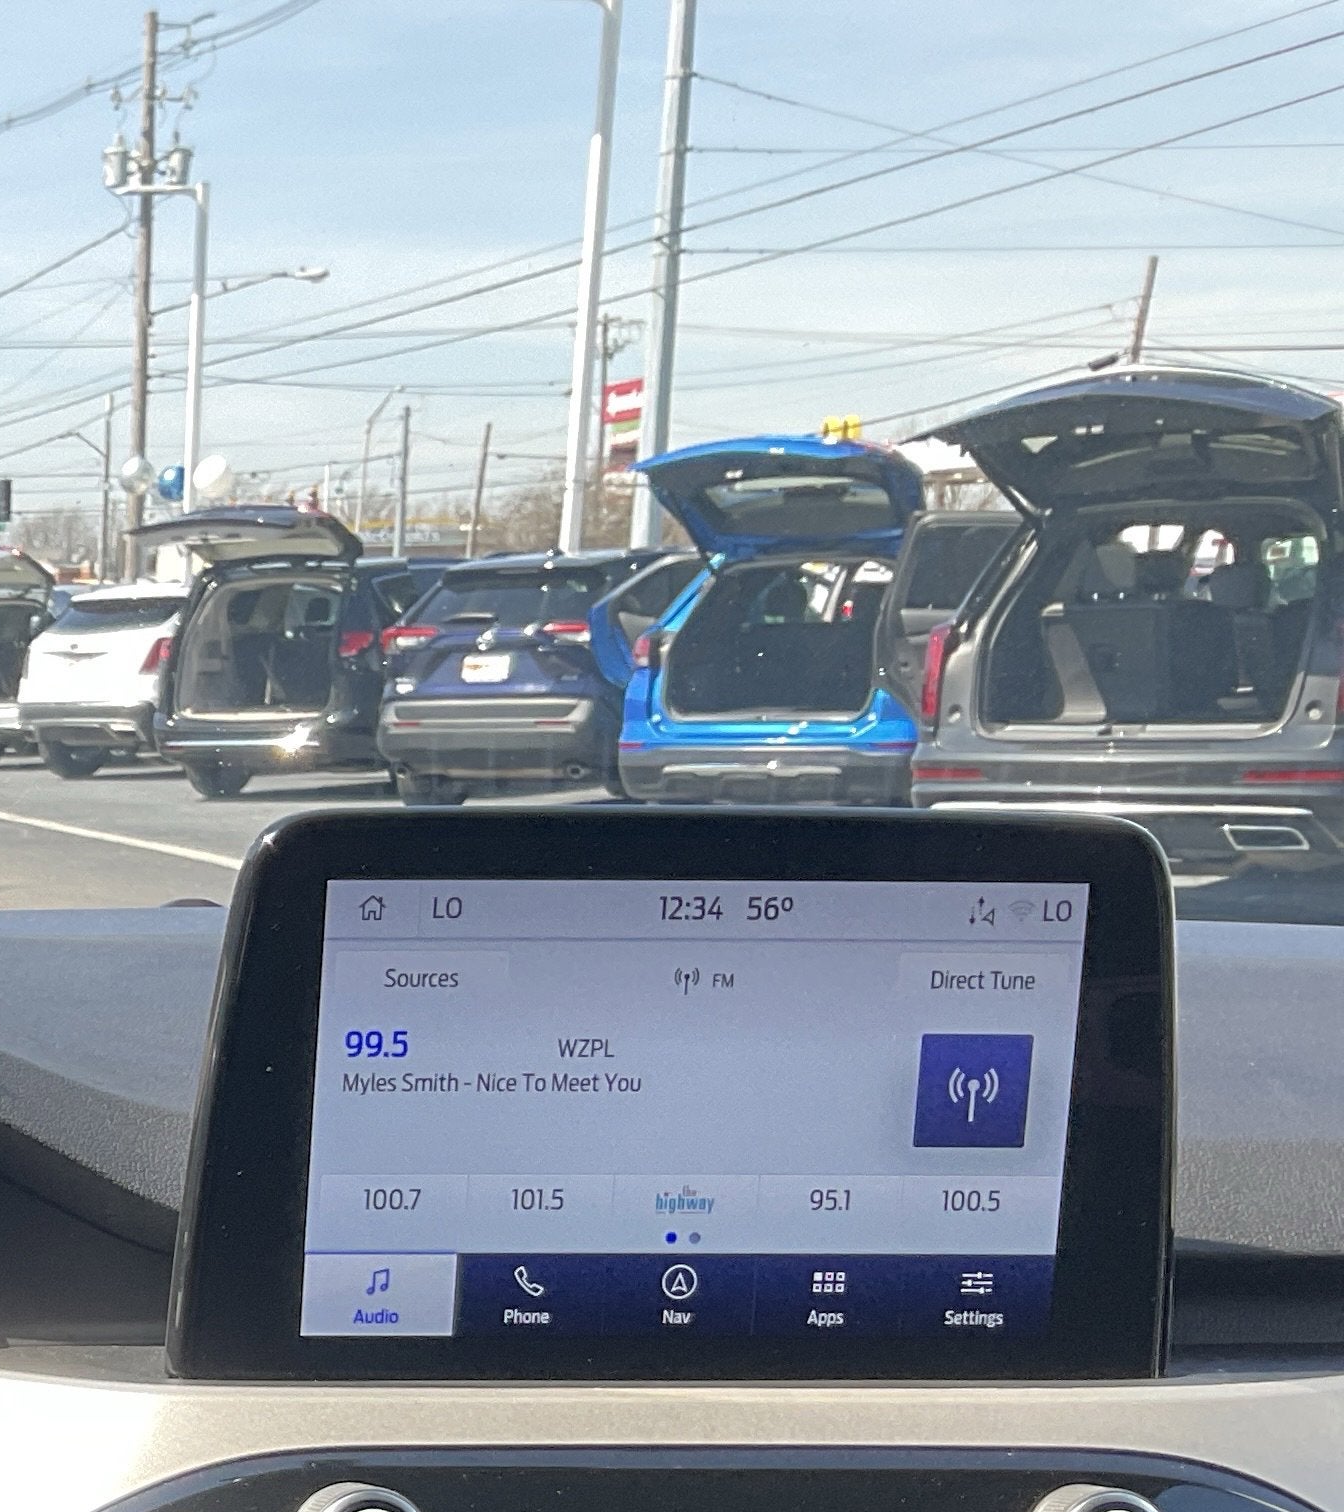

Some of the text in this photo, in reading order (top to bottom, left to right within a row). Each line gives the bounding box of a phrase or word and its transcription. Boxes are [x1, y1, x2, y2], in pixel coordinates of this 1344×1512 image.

[433, 896, 462, 919] LO
[660, 896, 724, 921] 12:34
[1043, 901, 1072, 922] LO
[384, 968, 459, 988] Sources
[713, 973, 734, 988] FM
[931, 971, 1036, 990] Direct Tune
[345, 1030, 409, 1058] 99.5
[558, 1038, 615, 1058] WZPL
[342, 1073, 396, 1096] Myles
[402, 1073, 459, 1092] Smith
[477, 1073, 517, 1093] Nice
[522, 1074, 546, 1092] To
[551, 1074, 599, 1092] Meet
[604, 1074, 642, 1093] You
[363, 1189, 421, 1210] 100.7
[511, 1189, 564, 1210] 101.5
[655, 1192, 715, 1214] highway
[810, 1189, 851, 1211] 95.1
[942, 1190, 1000, 1212] 100.5
[353, 1309, 399, 1324] Audio
[504, 1309, 550, 1324] Phone
[662, 1310, 690, 1324] Nav
[807, 1310, 844, 1328] Apps
[944, 1310, 1003, 1327] Settings
